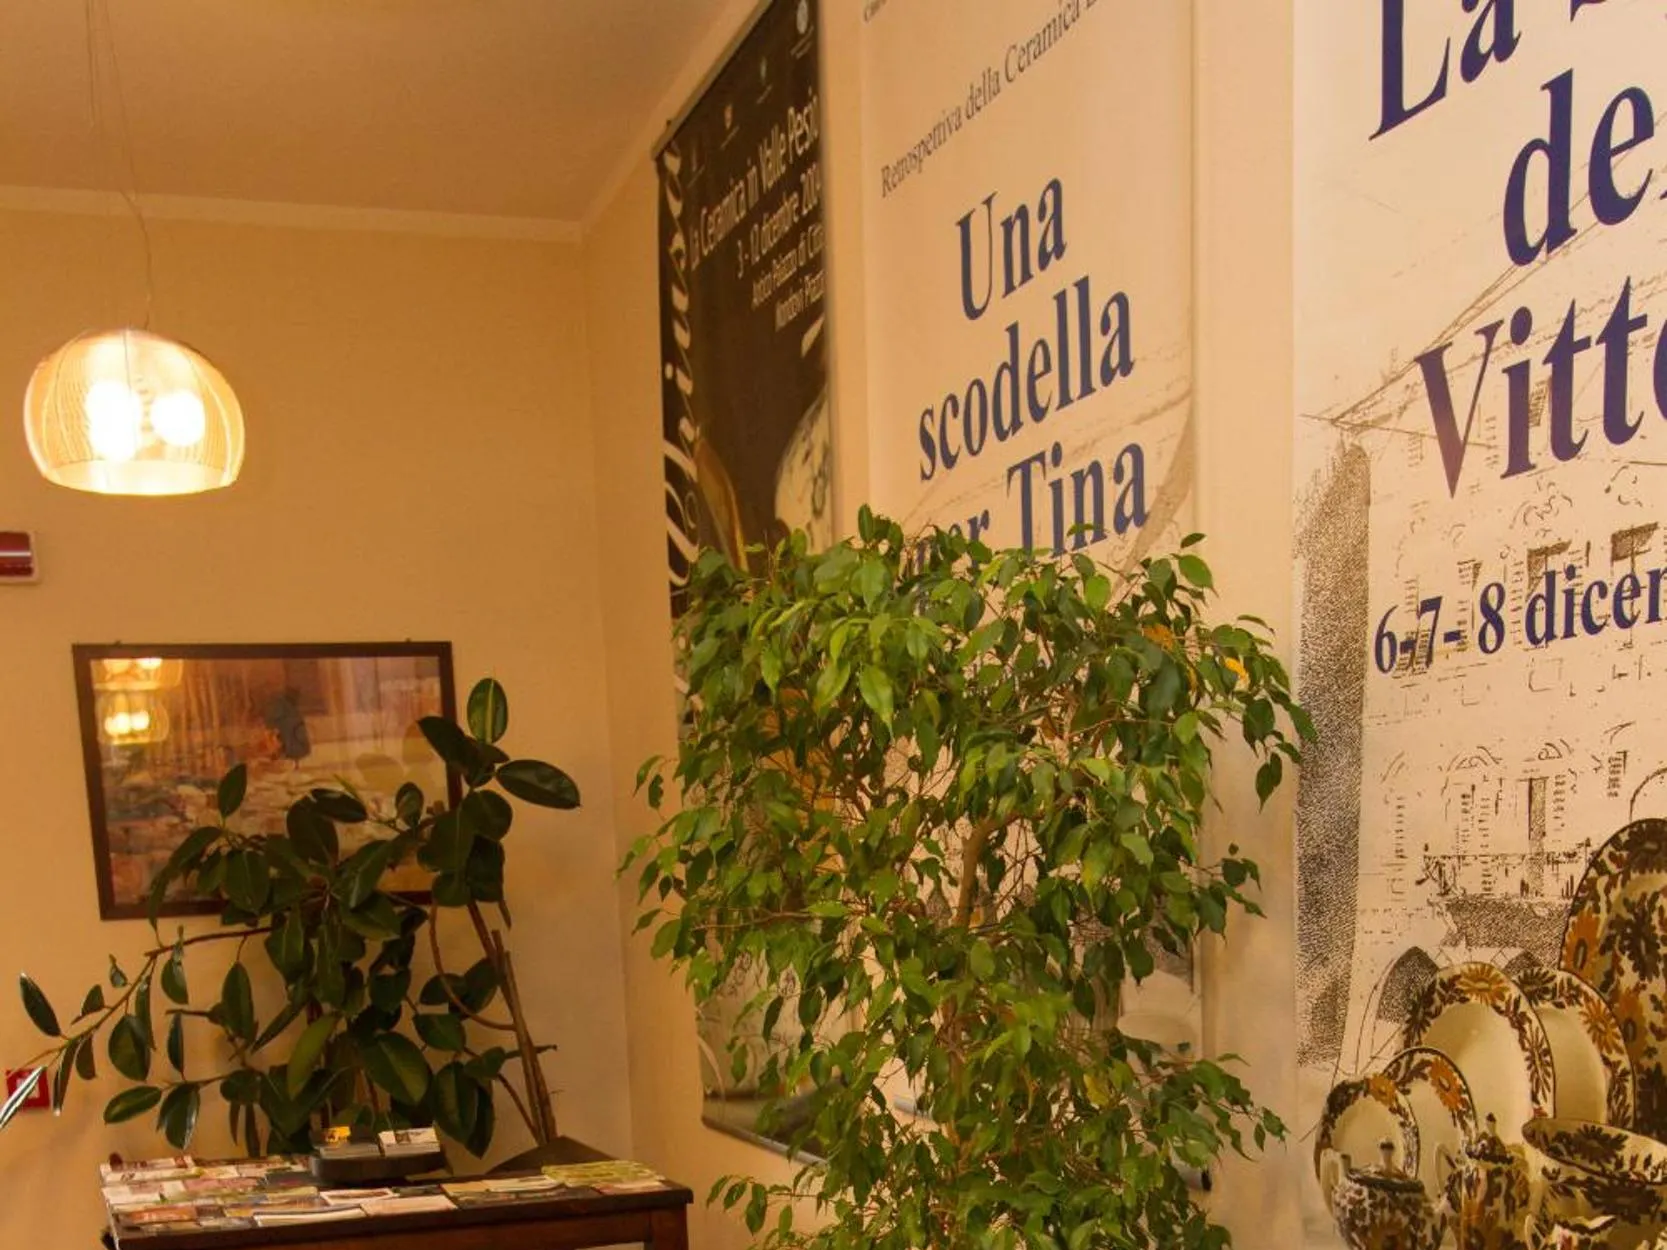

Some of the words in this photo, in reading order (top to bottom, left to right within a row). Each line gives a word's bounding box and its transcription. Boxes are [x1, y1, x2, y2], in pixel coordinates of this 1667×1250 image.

[881, 105, 963, 198] Retrospettiva
[966, 66, 1001, 121] della
[1004, 0, 1080, 84] Ceramica
[1503, 67, 1667, 267] de
[702, 177, 747, 257] Ceramica
[955, 176, 1068, 322] Una
[918, 275, 1135, 482] scodella
[1005, 441, 1150, 562] Tina
